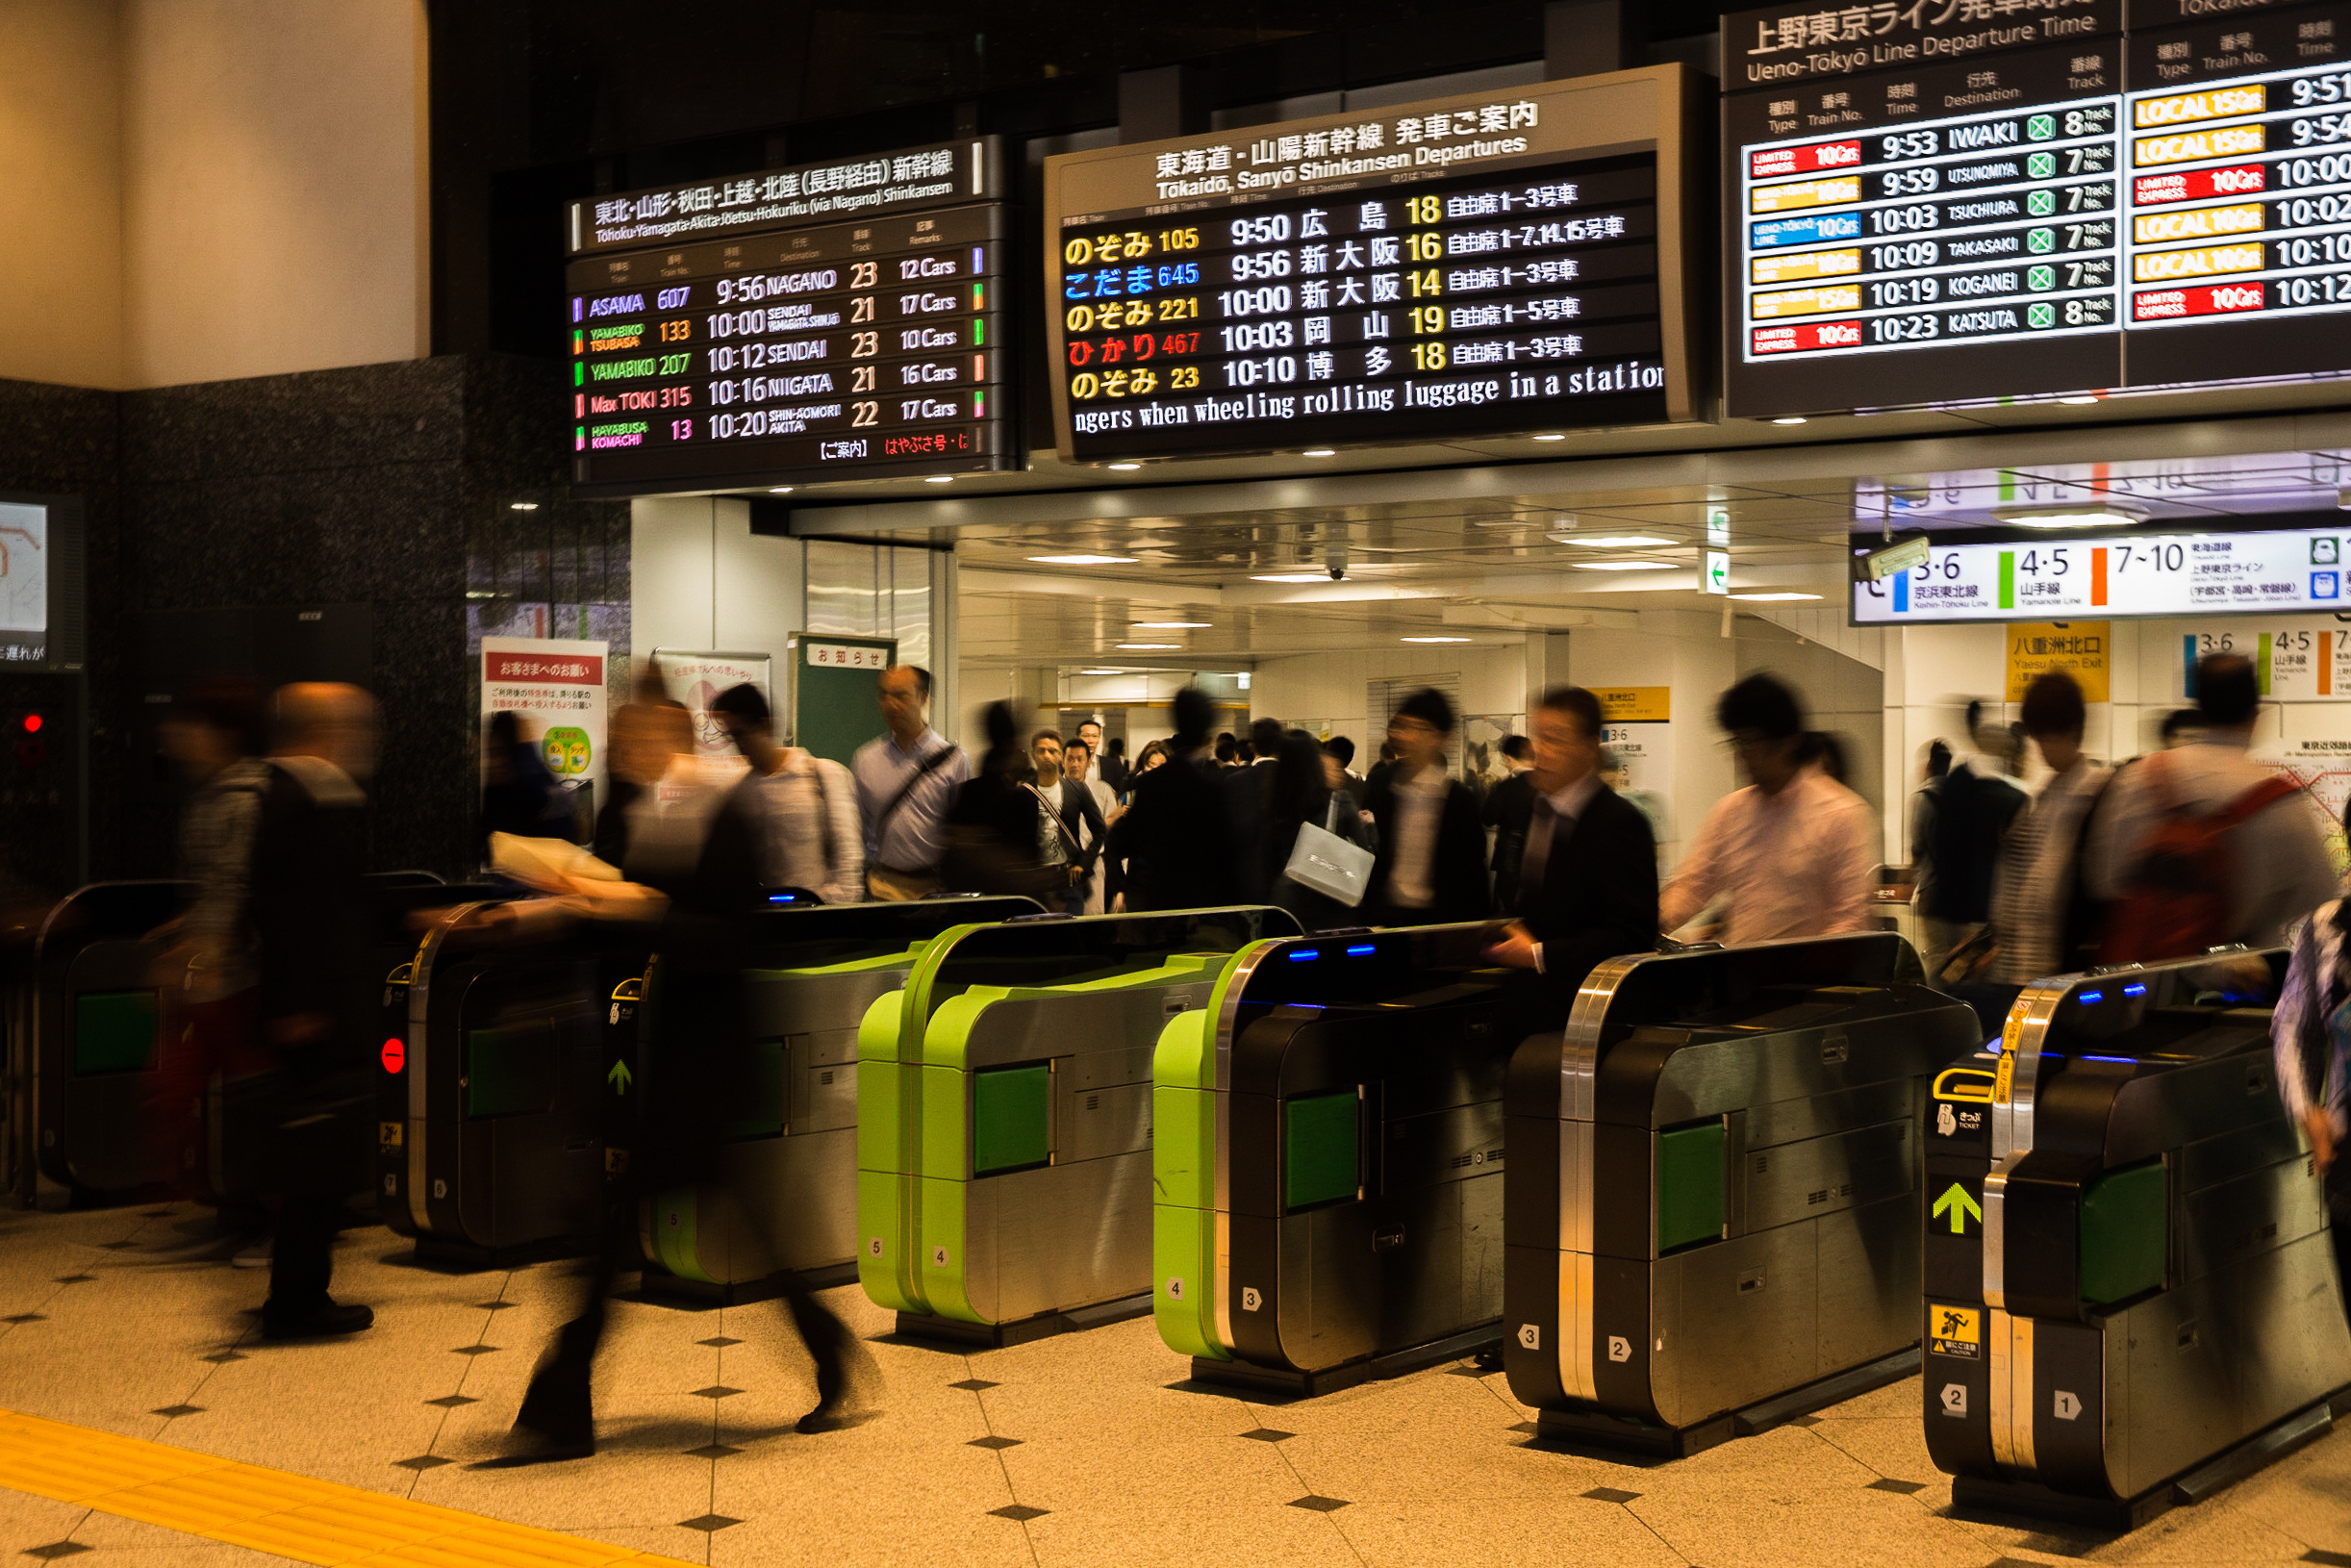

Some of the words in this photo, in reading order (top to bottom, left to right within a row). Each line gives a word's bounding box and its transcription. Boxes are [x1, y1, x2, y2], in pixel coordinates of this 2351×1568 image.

[1747, 48, 1870, 82] Ueno-Tōkyō
[1873, 42, 1919, 63] Line
[1923, 25, 2036, 57] Departure
[2039, 15, 2098, 38] Time
[1887, 82, 1917, 99] 時刻
[1966, 70, 1999, 89] 行先
[2070, 54, 2104, 74] 番線
[1768, 117, 1799, 134] Type
[1807, 111, 1840, 126] Train
[1841, 109, 1865, 122] No.
[1885, 100, 1918, 114] Time
[1944, 88, 2022, 108] Destination
[2067, 73, 2107, 90] Track
[2136, 95, 2212, 124] LOCAL
[1396, 100, 1538, 145] 発車ご案内
[1754, 150, 1796, 164] LIMITED
[1883, 131, 1938, 161] 9:53
[1949, 121, 2018, 149] IWAKI
[2065, 111, 2085, 137] 8
[893, 149, 953, 182] 新幹線
[1237, 165, 1297, 190] Sanyō
[1299, 151, 1411, 182] Shinkansen
[1415, 137, 1528, 165] Departures
[1754, 161, 1796, 176] EXPRESS
[1883, 167, 1938, 196] 9:59
[1947, 162, 2019, 184] UTSUNOMIYA
[810, 197, 831, 215] (via
[833, 190, 883, 211] Nagano)
[884, 183, 953, 203] Shinkansen
[1065, 232, 1152, 265] のぞみ
[1159, 228, 1200, 252] 105
[1230, 214, 1291, 246] 9:50
[1405, 195, 1442, 224] 18
[1870, 204, 1938, 234] 10:03
[1947, 199, 2019, 221] TSUCHIURA
[1065, 266, 1152, 299] こだま
[1157, 263, 1200, 288] 645
[1231, 249, 1291, 282] 9:56
[1405, 232, 1442, 262] 16
[1871, 240, 1939, 270] 10:09
[1947, 237, 2018, 257] TAKASAKI
[589, 293, 645, 317] ASAMA
[657, 287, 691, 310] 607
[717, 275, 767, 305] 9:56
[767, 269, 837, 296] NAGANO
[850, 262, 878, 289] 23
[899, 260, 920, 280] 12
[921, 257, 956, 277] Cars
[1067, 300, 1153, 332] のぞみ
[1158, 297, 1199, 321] 221
[1218, 285, 1293, 317] 10:00
[1406, 268, 1442, 297] 14
[1871, 277, 1939, 307] 10:19
[1948, 271, 2018, 296] KOGANEI
[590, 323, 645, 340] YAMABIKO
[659, 319, 691, 341] 133
[707, 309, 767, 339] 10:00
[767, 304, 812, 320] SENDAI
[850, 296, 874, 323] 21
[900, 294, 920, 315] 17
[921, 292, 957, 313] Cars
[1871, 314, 1938, 342] 10:23
[1949, 310, 2018, 333] KATSUTA
[590, 336, 641, 352] TSUBASA
[1069, 333, 1155, 367] ひかり
[1161, 332, 1201, 355] 467
[1220, 320, 1295, 352] 10:03
[1408, 306, 1446, 335] 19
[591, 358, 656, 381] YAMABIKO
[659, 353, 692, 375] 207
[707, 343, 767, 372] 10:12
[767, 340, 827, 365] SENDAI
[850, 331, 879, 358] 23
[1072, 367, 1158, 399] のぞみ
[1171, 367, 1200, 389] 23
[1223, 356, 1297, 387] 10:10
[1410, 341, 1447, 371] 18
[591, 395, 619, 414] Max
[619, 391, 657, 410] TOKI
[660, 386, 692, 408] 315
[708, 376, 767, 406] 10:16
[768, 373, 834, 397] NIIGATA
[851, 366, 875, 392] 21
[1074, 409, 1132, 434] ngers
[1138, 401, 1189, 426] when
[1194, 392, 1296, 423] wheeling
[1303, 384, 1395, 416] rolling
[1404, 379, 1500, 408] luggage
[1509, 371, 1536, 399] in
[1545, 375, 1560, 395] a
[592, 421, 649, 437] HAYABUSA
[671, 419, 693, 441] 13
[709, 411, 767, 440] 10:20
[769, 404, 841, 422] SHIN-AOMORI
[851, 401, 879, 427] 22
[592, 433, 642, 449] KOMACHI
[769, 419, 806, 435] AKITA
[1913, 584, 1979, 599] 京浜東北線
[2020, 582, 2060, 595] 山手線
[818, 649, 880, 666] お知らせ
[2013, 636, 2101, 655] 八重洲北口
[2275, 654, 2307, 665] 山手線
[499, 662, 590, 677] お客さまへのお願い
[2013, 659, 2046, 670] Yaesu
[2082, 657, 2102, 669] Exit
[1959, 1112, 1982, 1123] きっぷ
[670, 1214, 677, 1225] 5
[872, 1241, 880, 1254] 5
[936, 1251, 945, 1263] 4
[1171, 1282, 1180, 1295] 4
[1246, 1293, 1255, 1306] 3
[1526, 1329, 1534, 1344] 3
[1613, 1342, 1624, 1356] 2
[1951, 1390, 1961, 1405] 2
[2060, 1397, 2069, 1413] 1
